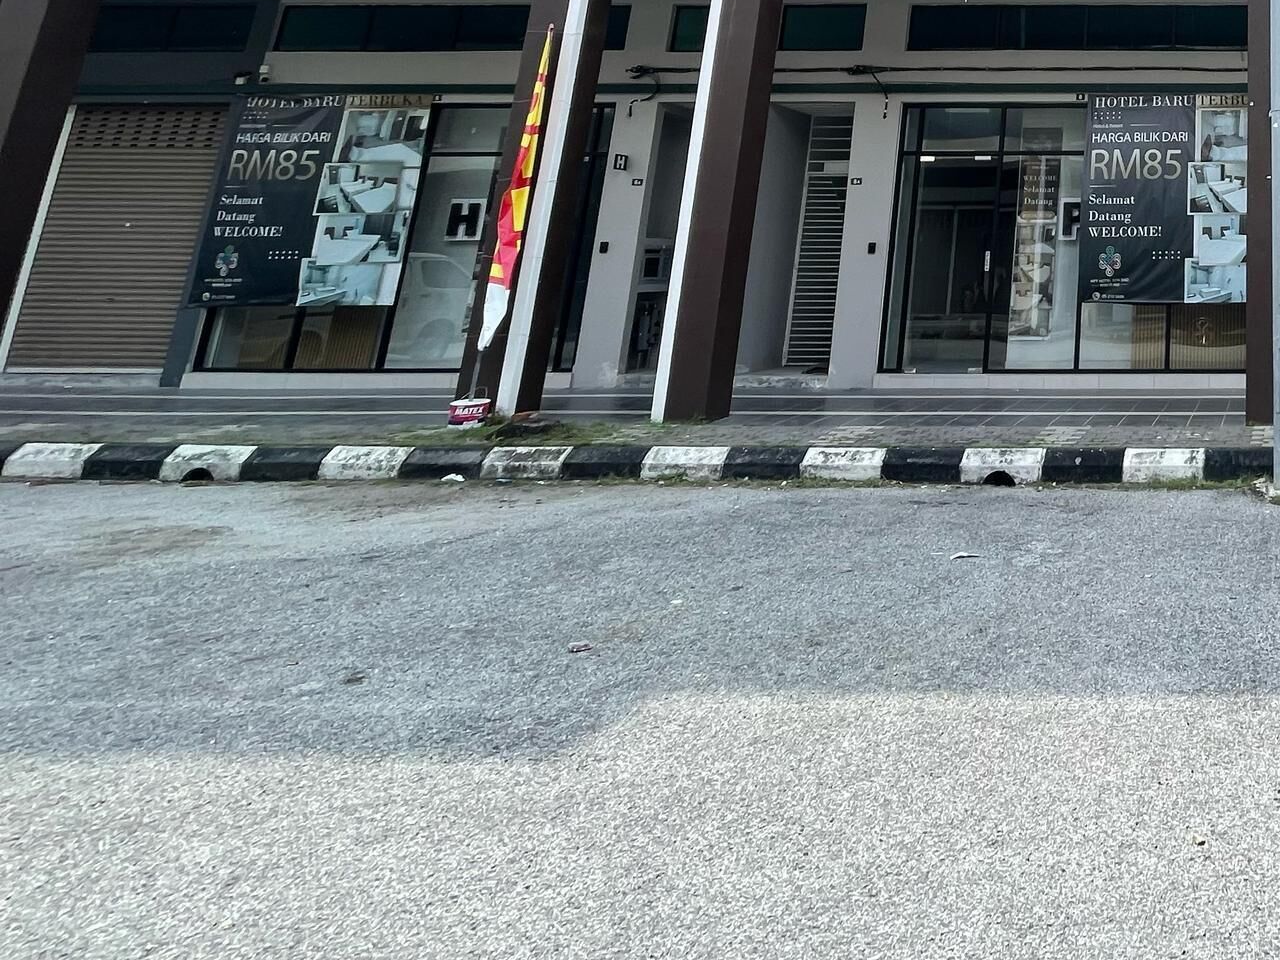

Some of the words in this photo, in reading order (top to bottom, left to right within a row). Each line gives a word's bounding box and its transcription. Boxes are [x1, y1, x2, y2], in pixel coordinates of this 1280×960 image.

[1095, 96, 1148, 108] HOTEL
[1152, 95, 1194, 107] BARU
[236, 132, 272, 143] HARGA
[273, 132, 300, 143] BILIK
[300, 132, 331, 142] DARI
[1092, 132, 1131, 143] HARGA
[1134, 132, 1160, 142] BILIK
[1162, 132, 1188, 142] DARI
[227, 149, 320, 181] RM85
[615, 155, 626, 170] H
[1090, 148, 1182, 180] RM85
[1023, 185, 1055, 193] Selamat
[220, 194, 263, 205] Selamat
[1024, 197, 1053, 206] Datang
[1088, 194, 1135, 205] Selamat
[217, 210, 256, 223] Datang
[445, 202, 484, 239] H
[1088, 210, 1132, 224] Datang
[214, 226, 284, 237] WELCOME!
[1088, 226, 1162, 238] WELCOME!
[454, 406, 485, 415] MATEX
